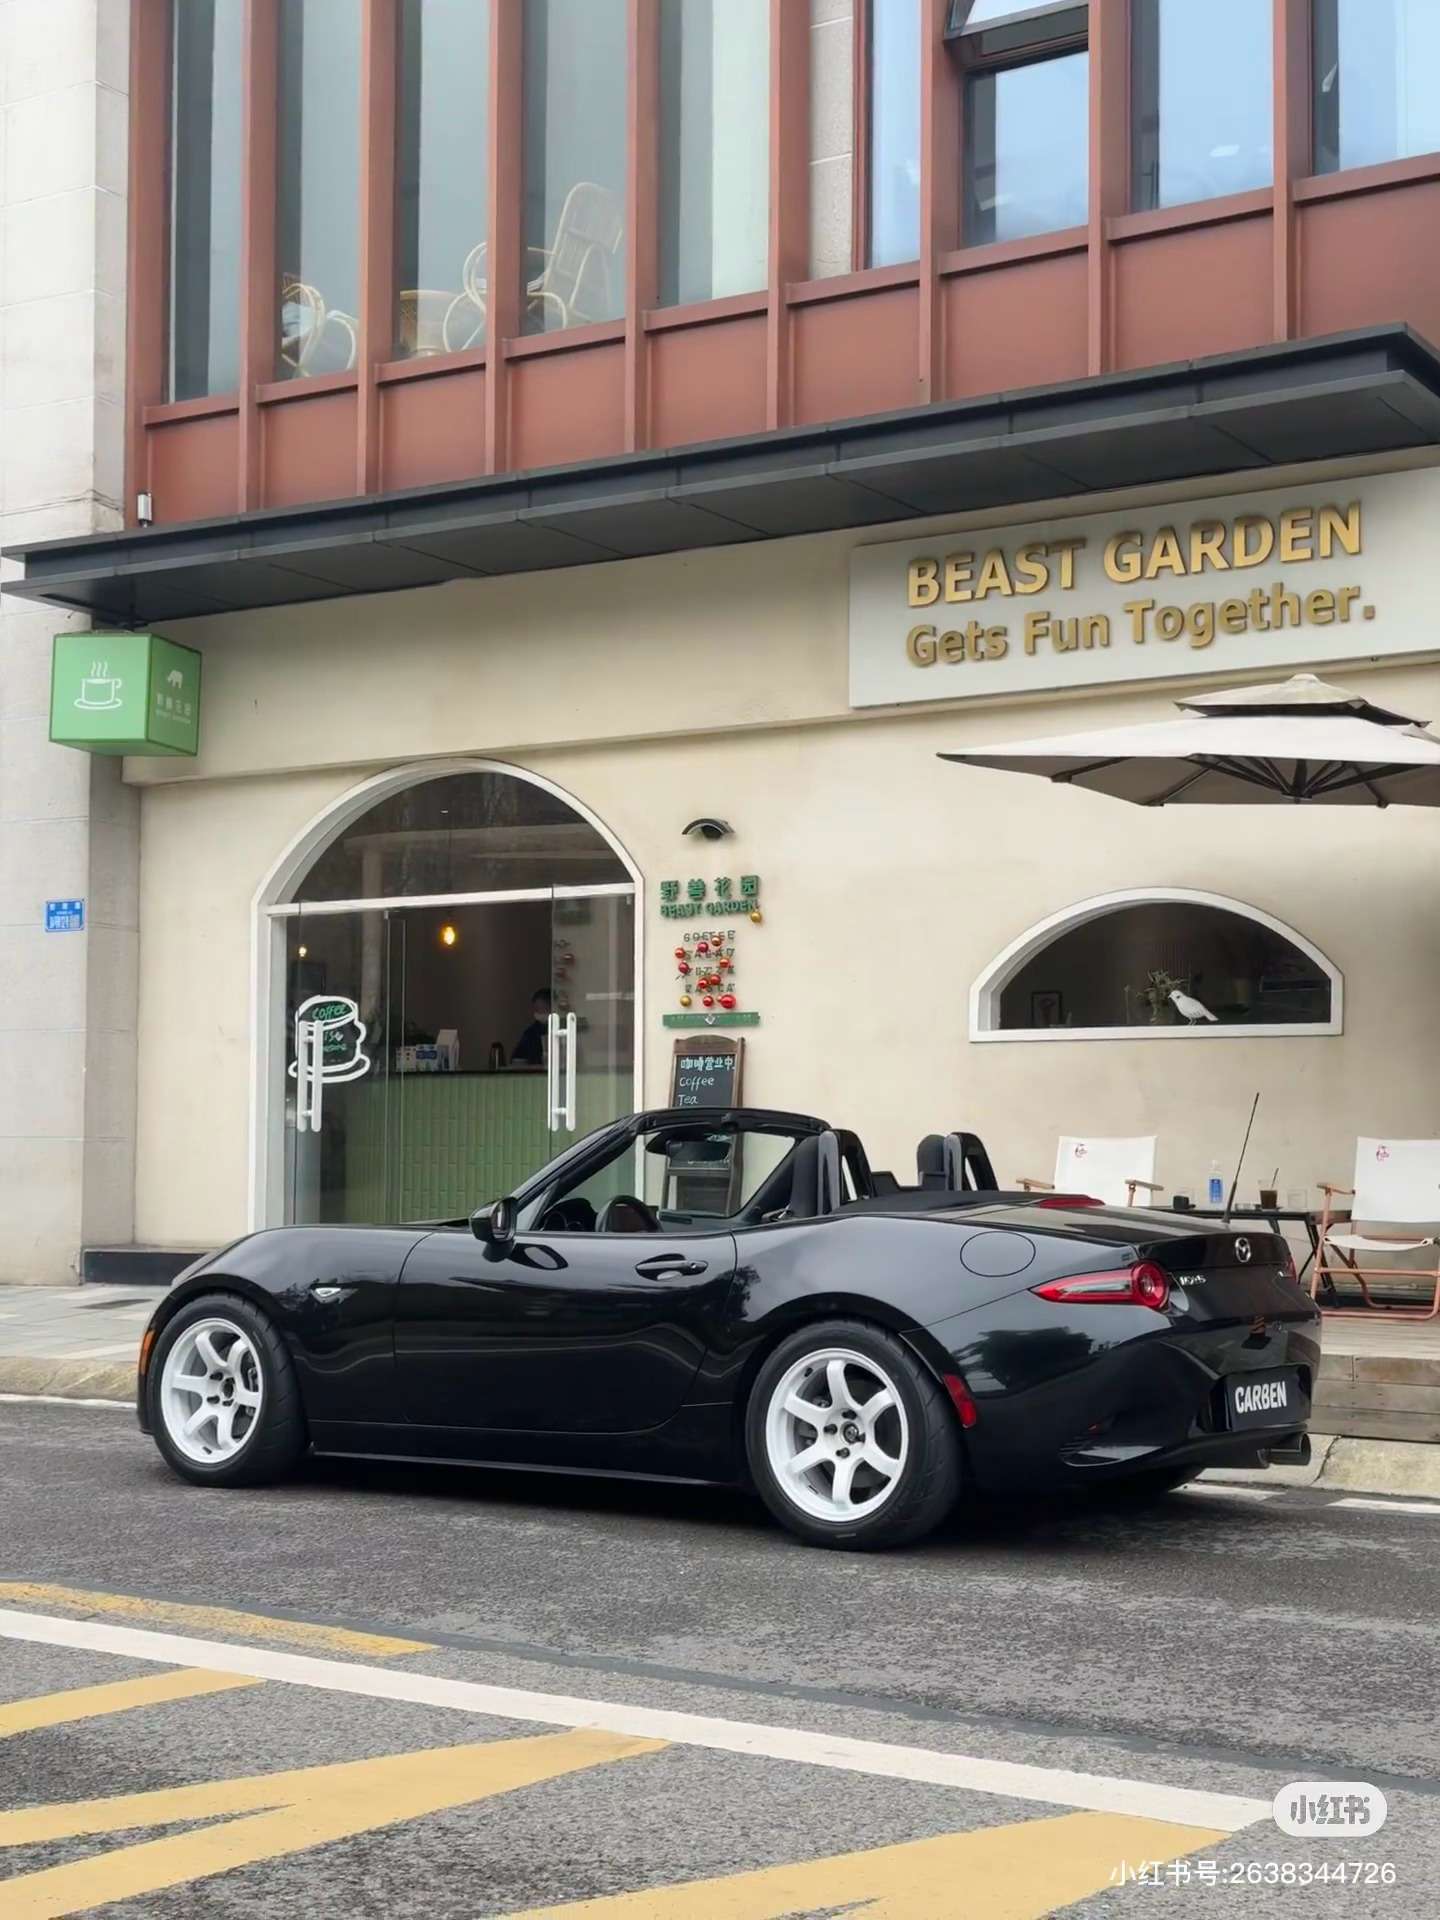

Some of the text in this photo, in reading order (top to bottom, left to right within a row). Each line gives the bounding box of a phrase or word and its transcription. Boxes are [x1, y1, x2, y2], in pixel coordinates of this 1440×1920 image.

[907, 501, 1362, 607] BEAST GARDEN
[906, 583, 1376, 668] Gets Fun Together.
[660, 875, 760, 902] 野兽花园
[679, 1076, 714, 1091] Coffee
[678, 1094, 698, 1106] Tea
[1234, 1380, 1287, 1414] CARBEN
